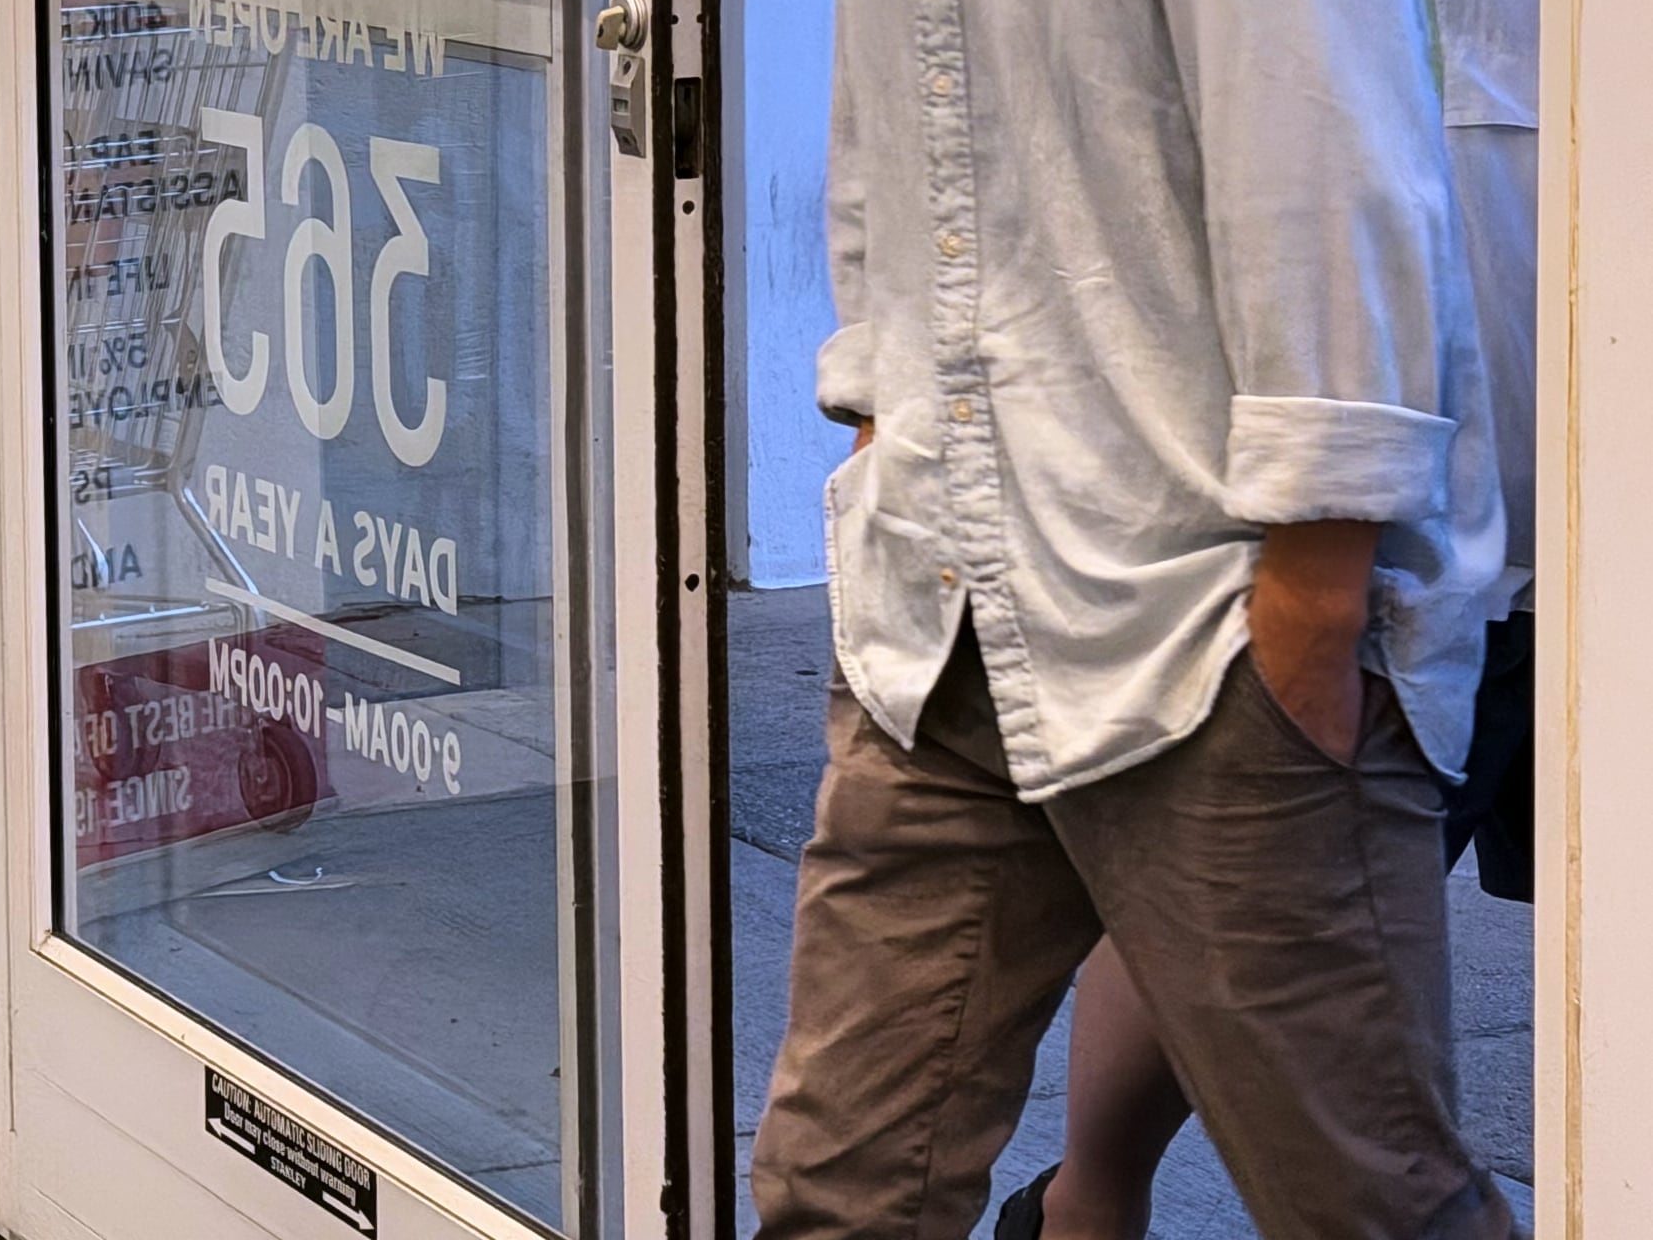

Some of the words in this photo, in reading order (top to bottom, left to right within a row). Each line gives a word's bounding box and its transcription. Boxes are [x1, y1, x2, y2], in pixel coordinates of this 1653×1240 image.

[212, 1073, 251, 1114] CAUTION:
[254, 1099, 306, 1147] AUTOMATIC
[307, 1134, 342, 1173] SLIDING
[344, 1157, 370, 1191] DOOR
[224, 1102, 243, 1130] Door
[245, 1117, 261, 1145] may
[263, 1129, 286, 1156] close
[287, 1146, 319, 1178] without
[320, 1169, 356, 1207] warning
[270, 1156, 306, 1189] STANLEY
